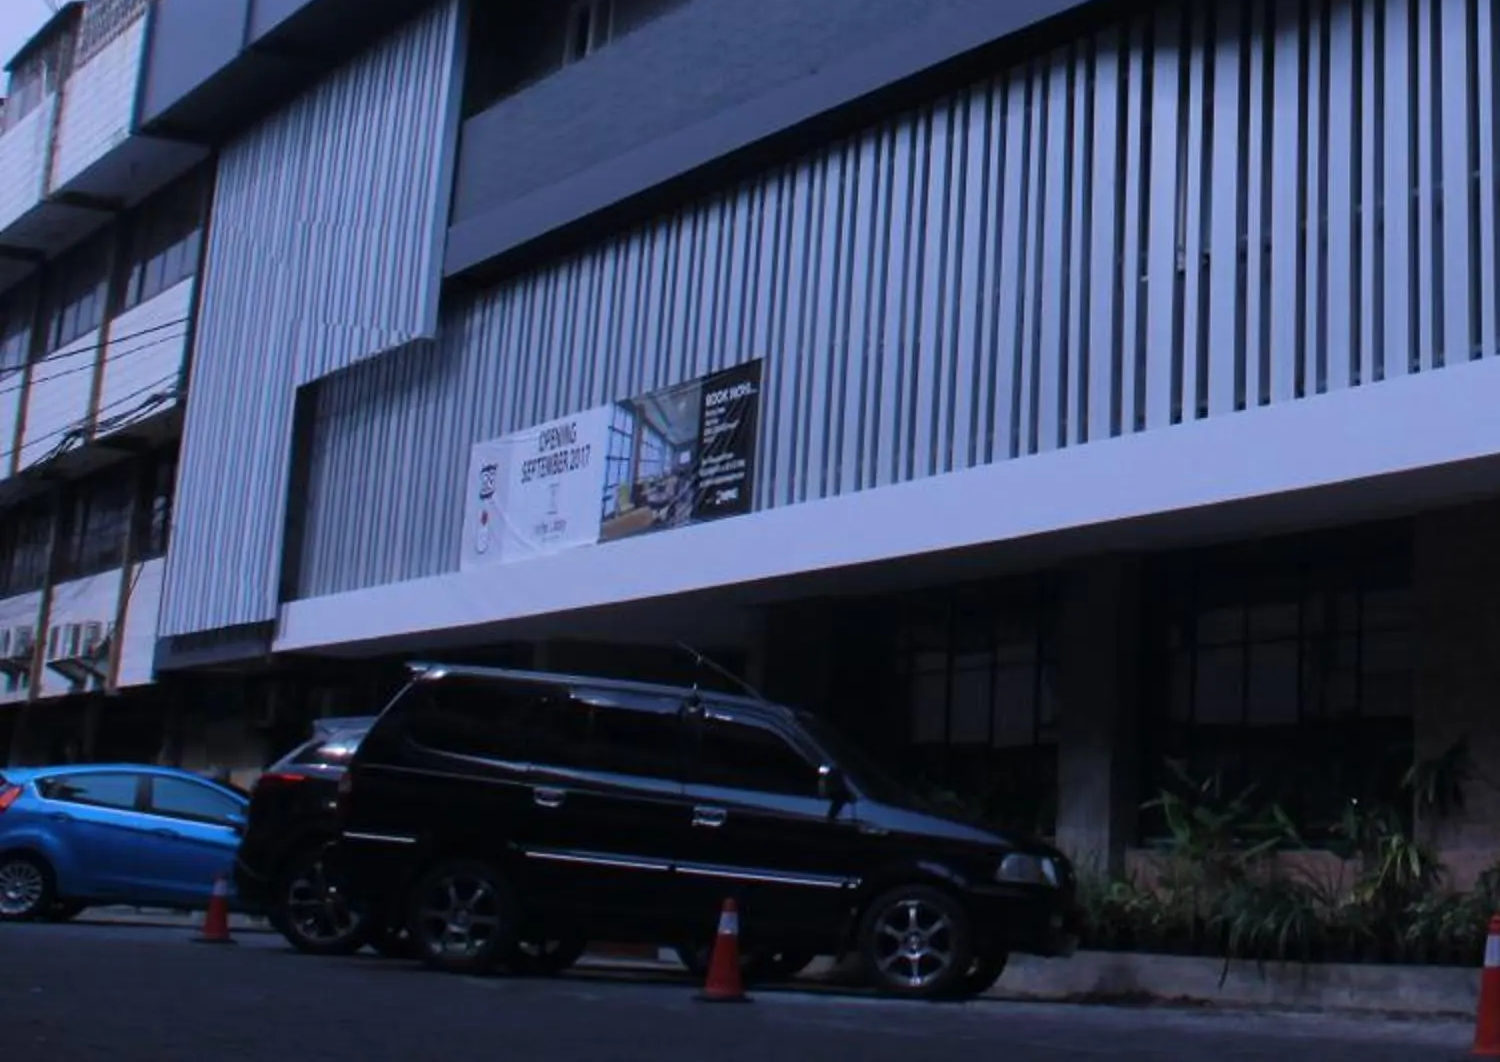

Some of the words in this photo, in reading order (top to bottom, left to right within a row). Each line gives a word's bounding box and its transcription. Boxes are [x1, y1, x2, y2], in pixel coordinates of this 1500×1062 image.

[540, 422, 577, 452] OPENING
[521, 449, 569, 484] SEPTEMBER
[569, 444, 591, 471] 2017
